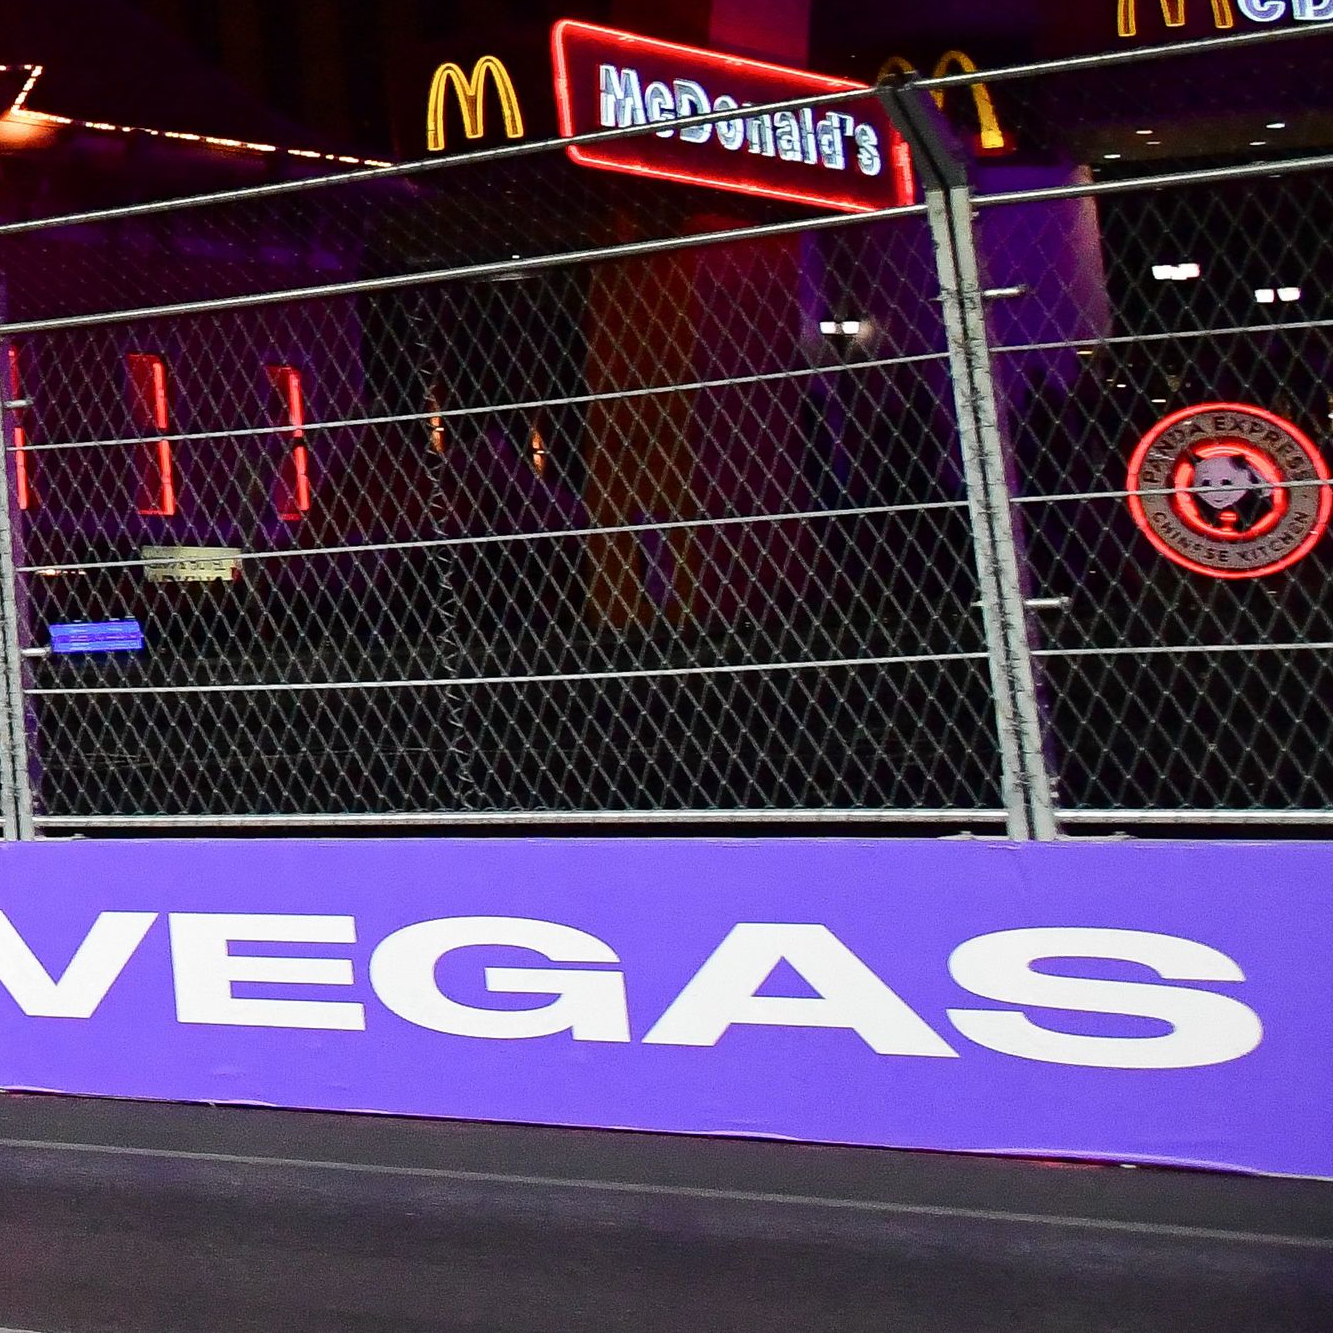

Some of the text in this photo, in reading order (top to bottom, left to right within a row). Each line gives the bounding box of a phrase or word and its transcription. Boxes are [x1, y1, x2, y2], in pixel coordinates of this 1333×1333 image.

[599, 63, 882, 176] McDonald's
[1142, 422, 1204, 484] PANDA
[1152, 510, 1309, 564] CHINESE KITCHEN
